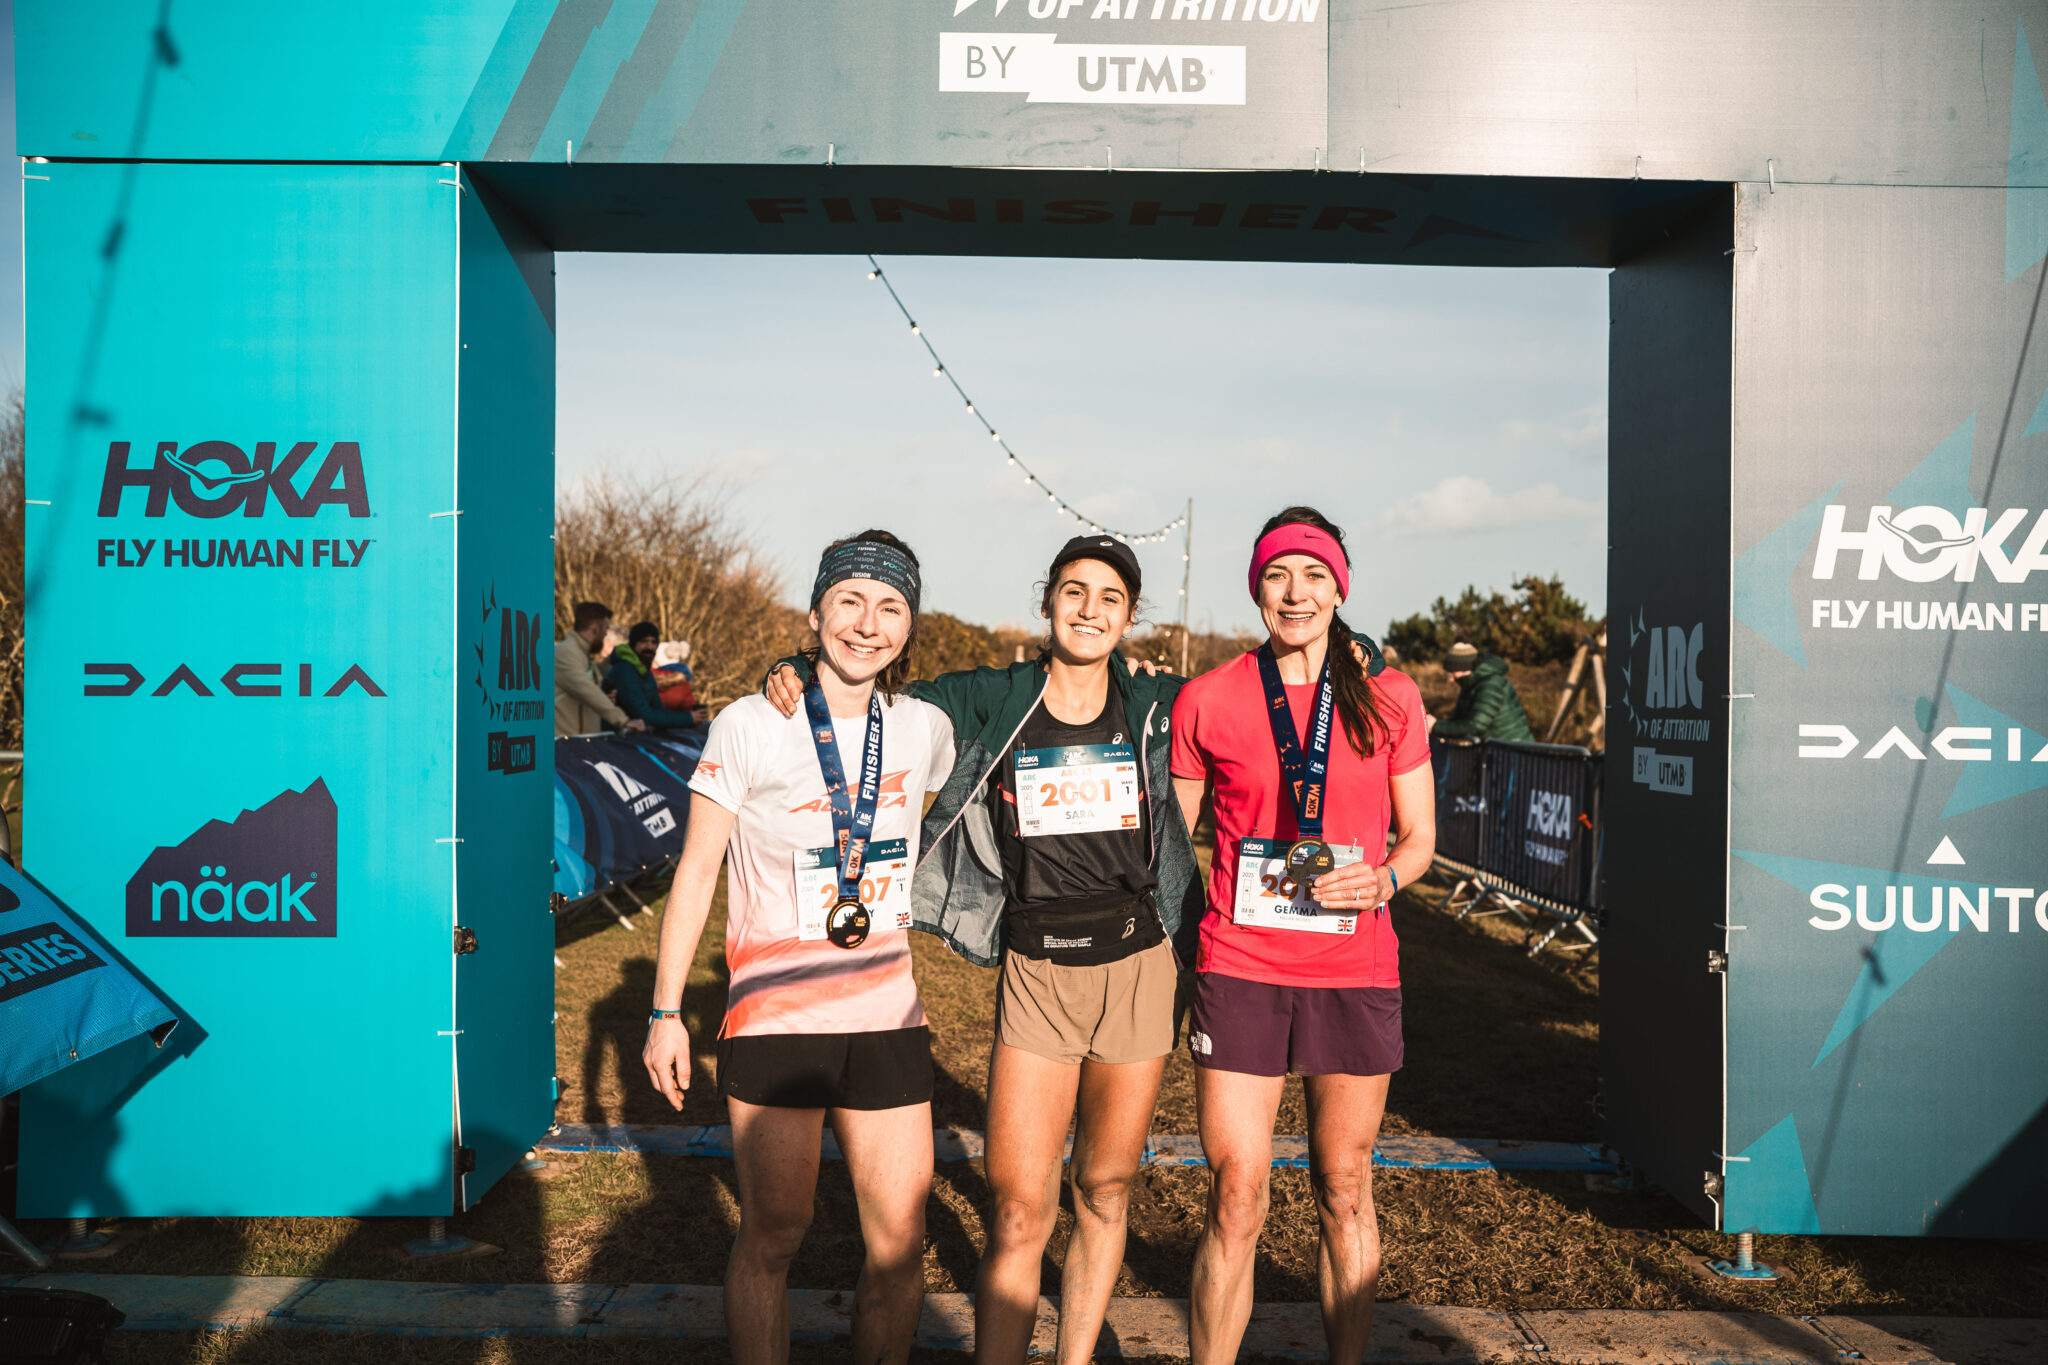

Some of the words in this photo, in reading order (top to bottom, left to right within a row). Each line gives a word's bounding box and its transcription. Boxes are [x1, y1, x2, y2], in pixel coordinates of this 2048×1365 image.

[966, 45, 1016, 79] BY
[1077, 55, 1207, 94] UTMB
[744, 196, 1400, 236] FINISHER
[97, 440, 371, 519] HOKA
[98, 539, 156, 567] FLY
[163, 539, 303, 568] HUMAN
[312, 539, 371, 567] FLY
[1812, 599, 1870, 630] FLY
[1876, 599, 2013, 632] HUMAN
[498, 606, 541, 691] ARC
[1645, 621, 1704, 709] ARC
[83, 662, 388, 697] DACIA
[503, 701, 513, 722] OF
[513, 701, 545, 722] ATTRITION
[1314, 682, 1333, 753] FINISHER
[1650, 718, 1662, 739] OF
[1662, 718, 1710, 742] ATTRITION
[1799, 724, 2048, 762] DACI
[492, 740, 502, 763] BY
[511, 742, 530, 767] UTMB
[862, 720, 881, 801] FINISHER
[1018, 755, 1039, 764] HOKA
[1637, 754, 1649, 775] BY
[1658, 761, 1685, 787] UTMB
[1040, 778, 1111, 807] 2001
[1125, 786, 1130, 795] 1
[1307, 798, 1317, 815] 50K
[1065, 809, 1095, 820] SARA
[1526, 789, 1572, 841] HOKA
[881, 847, 905, 855] DACIA
[1243, 843, 1264, 852] HOKA
[151, 865, 318, 923] näak
[820, 876, 891, 909] 207
[1808, 883, 2048, 932] SUUNT
[1274, 905, 1318, 917] GEMMA
